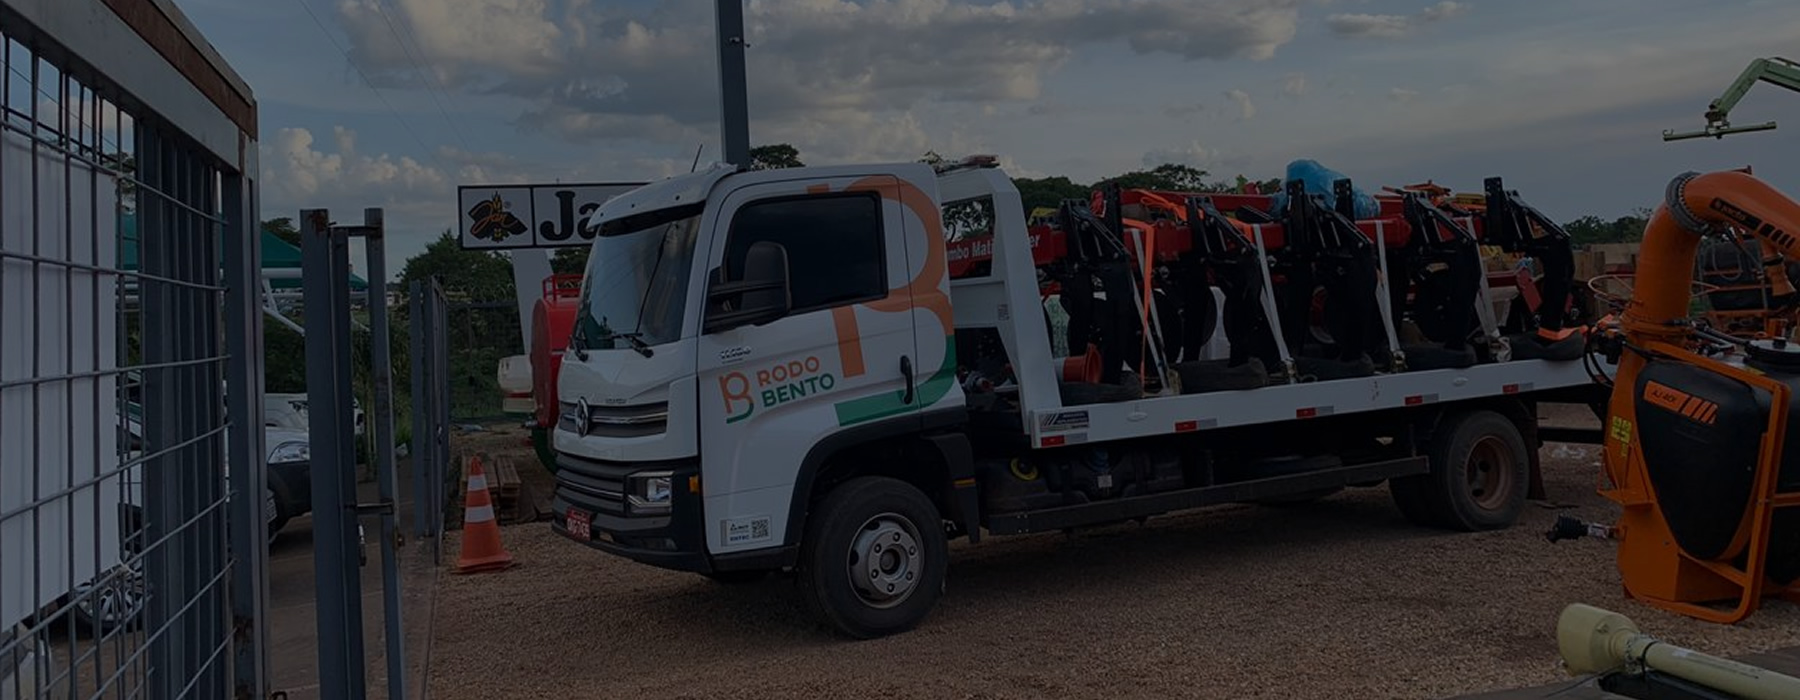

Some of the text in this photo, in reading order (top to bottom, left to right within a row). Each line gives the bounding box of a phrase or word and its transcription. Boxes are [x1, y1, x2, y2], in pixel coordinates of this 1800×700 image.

[540, 191, 601, 241] Ja
[757, 356, 819, 386] RODO
[761, 373, 834, 407] BENTO
